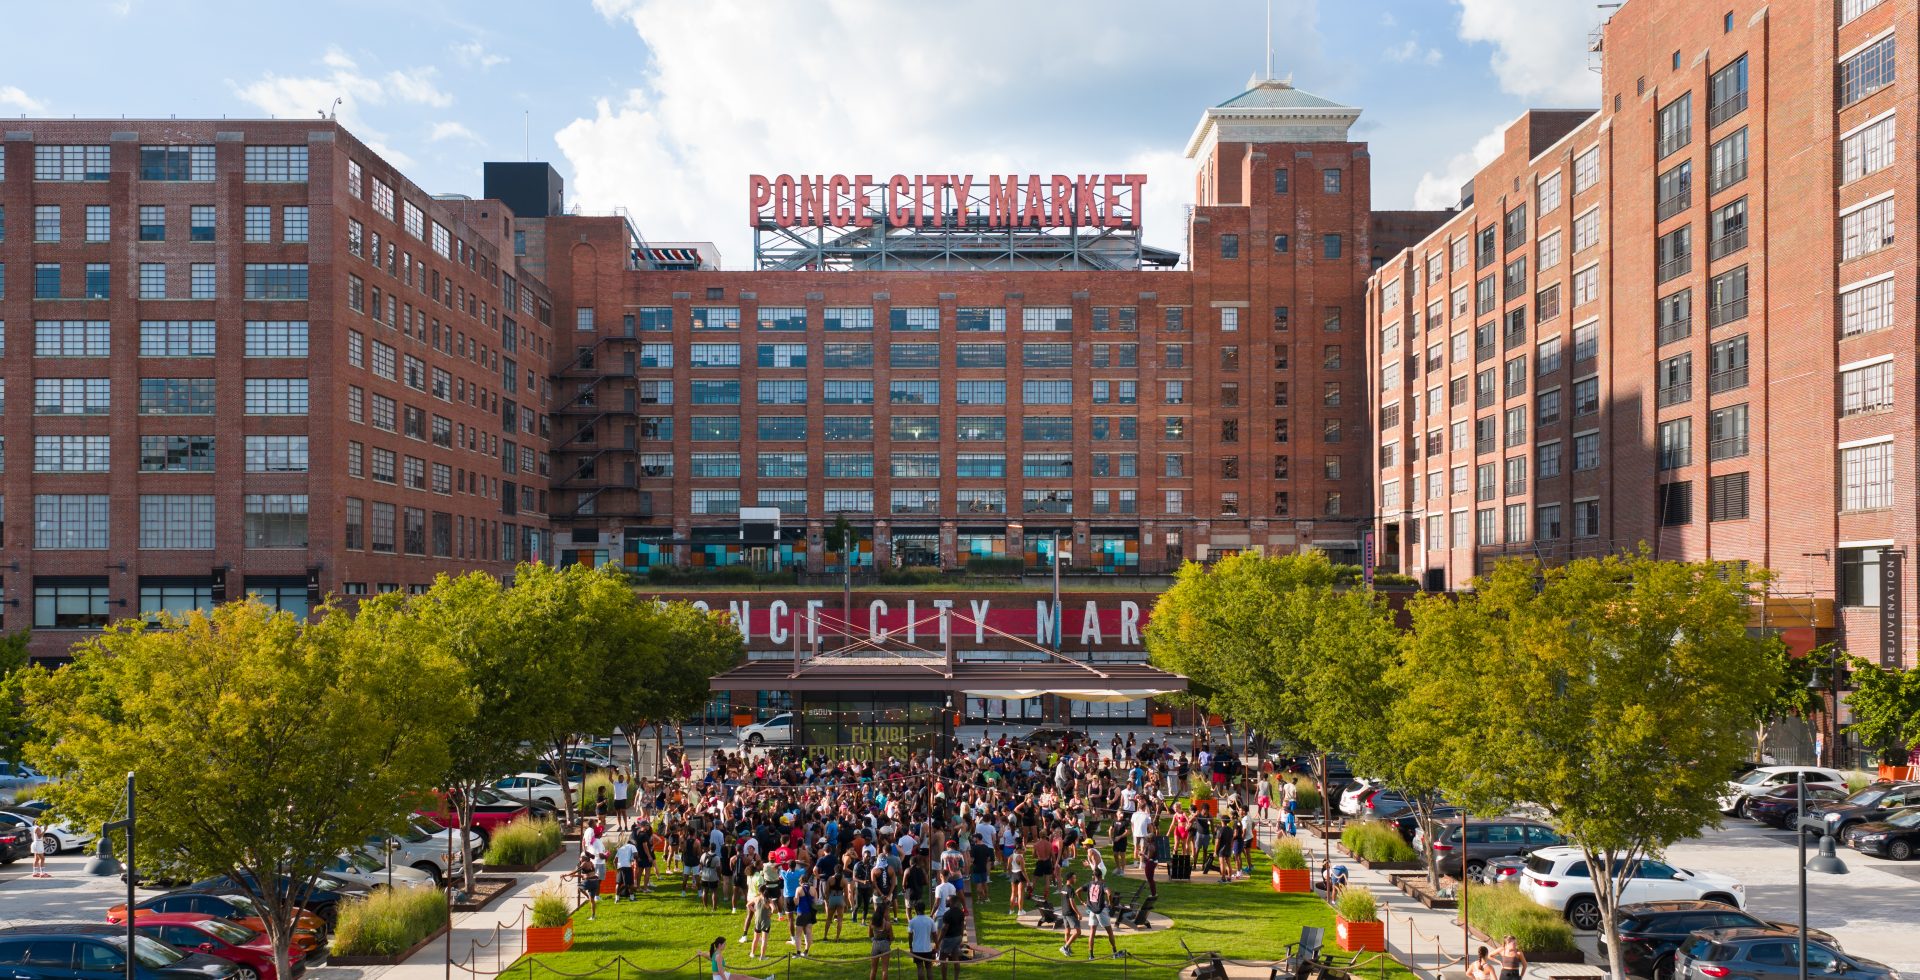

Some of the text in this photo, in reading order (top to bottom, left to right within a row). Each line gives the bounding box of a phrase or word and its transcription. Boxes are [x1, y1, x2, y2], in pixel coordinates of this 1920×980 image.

[750, 174, 1147, 229] PONCE CITY MARKET
[869, 599, 990, 644] CITY
[1887, 560, 1895, 662] REJUVENATION
[851, 726, 916, 743] FLEXIBLE
